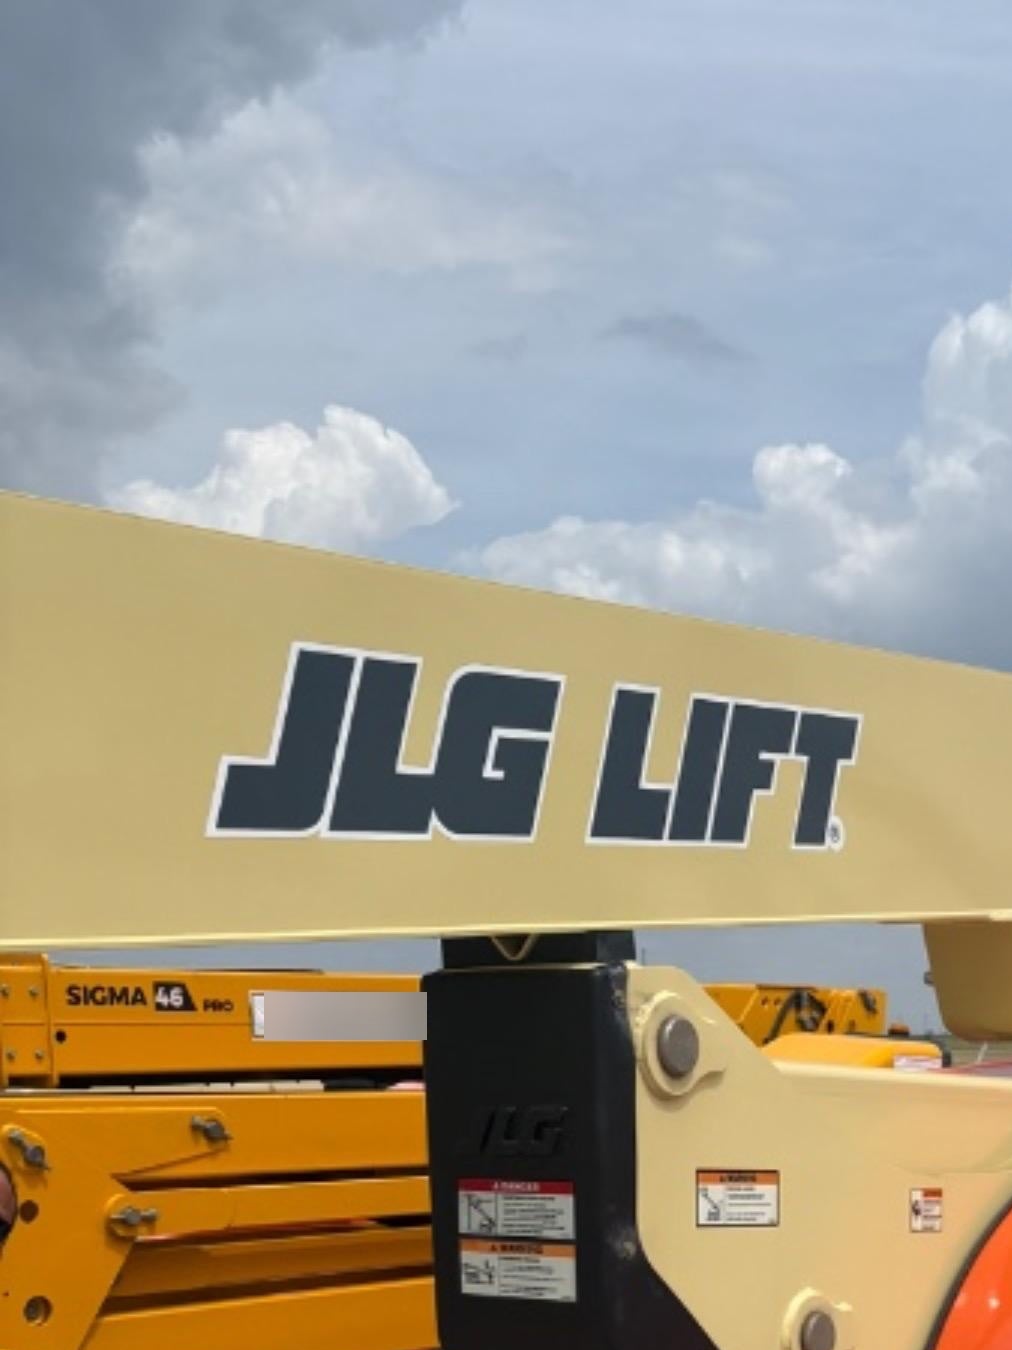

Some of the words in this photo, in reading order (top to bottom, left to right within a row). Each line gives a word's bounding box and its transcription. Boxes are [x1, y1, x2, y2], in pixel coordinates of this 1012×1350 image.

[206, 641, 566, 842] JLG
[586, 682, 863, 848] LIFT
[66, 984, 147, 1006] SIGMA
[155, 986, 184, 1009] 46
[203, 998, 234, 1013] PRO
